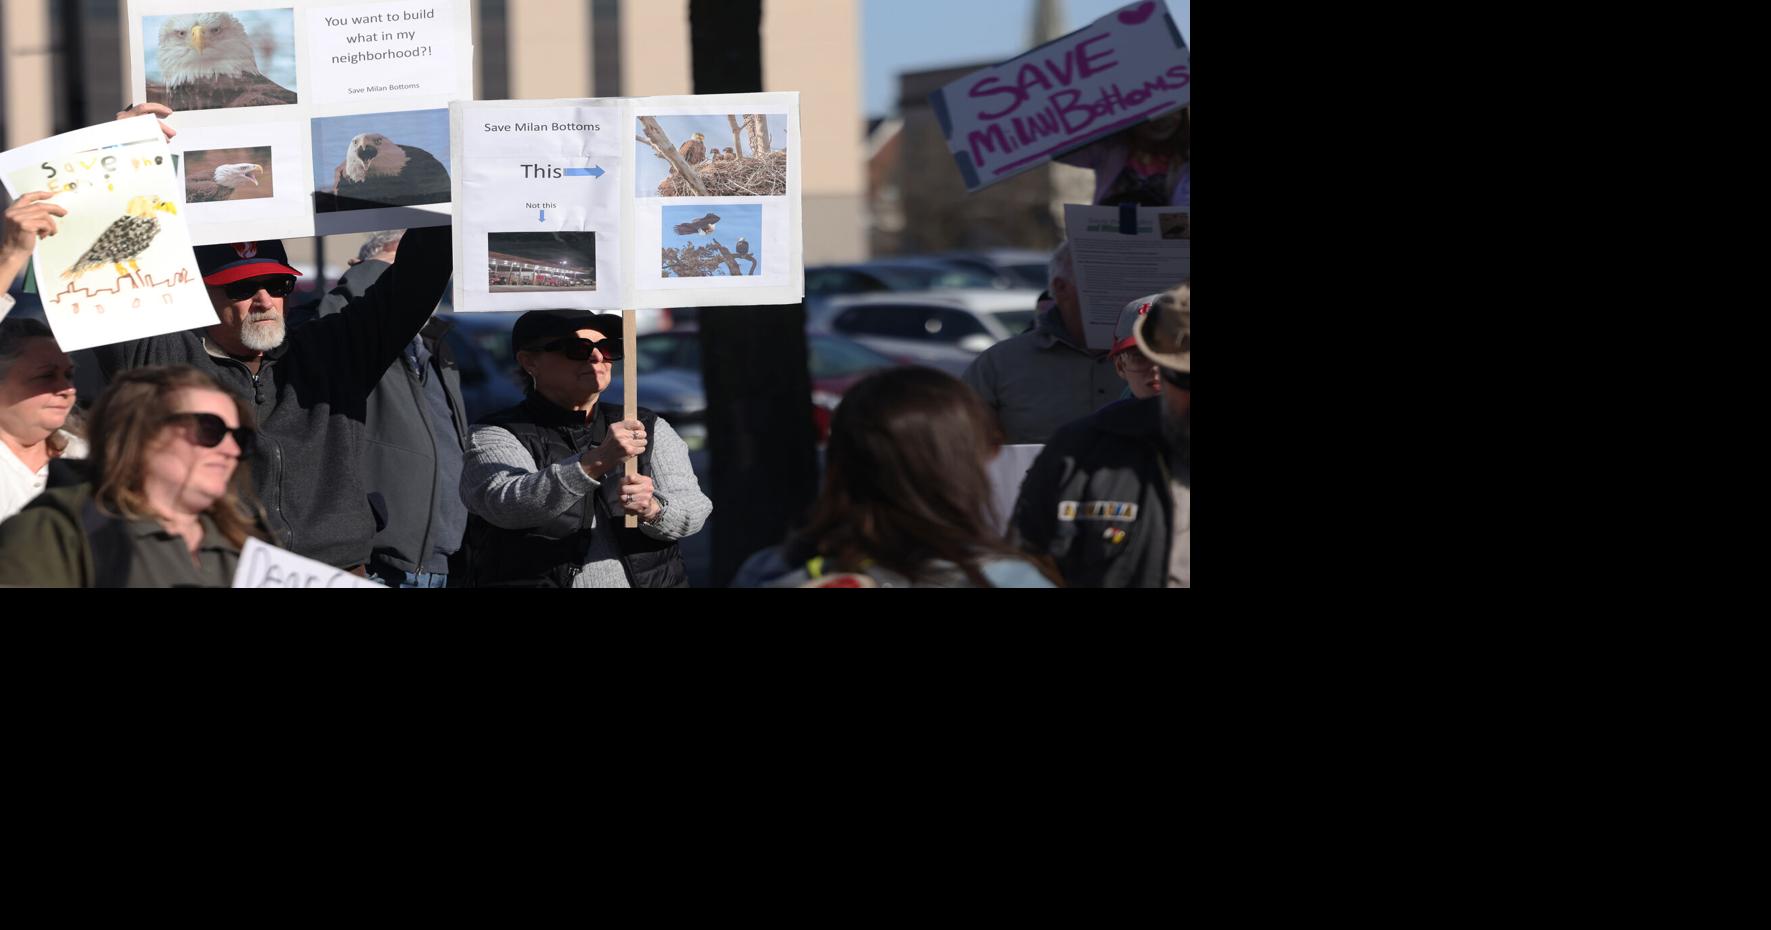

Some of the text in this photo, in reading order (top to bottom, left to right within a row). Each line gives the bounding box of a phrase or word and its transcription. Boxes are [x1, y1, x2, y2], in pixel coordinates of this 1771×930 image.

[324, 8, 435, 27] You want to build
[346, 30, 416, 44] what in my
[331, 45, 432, 65] neighborhood?!
[968, 32, 1119, 121] SAVE
[347, 82, 420, 95] Save Milan Bottoms
[484, 122, 601, 133] Save Milan Bottoms
[520, 163, 562, 179] This
